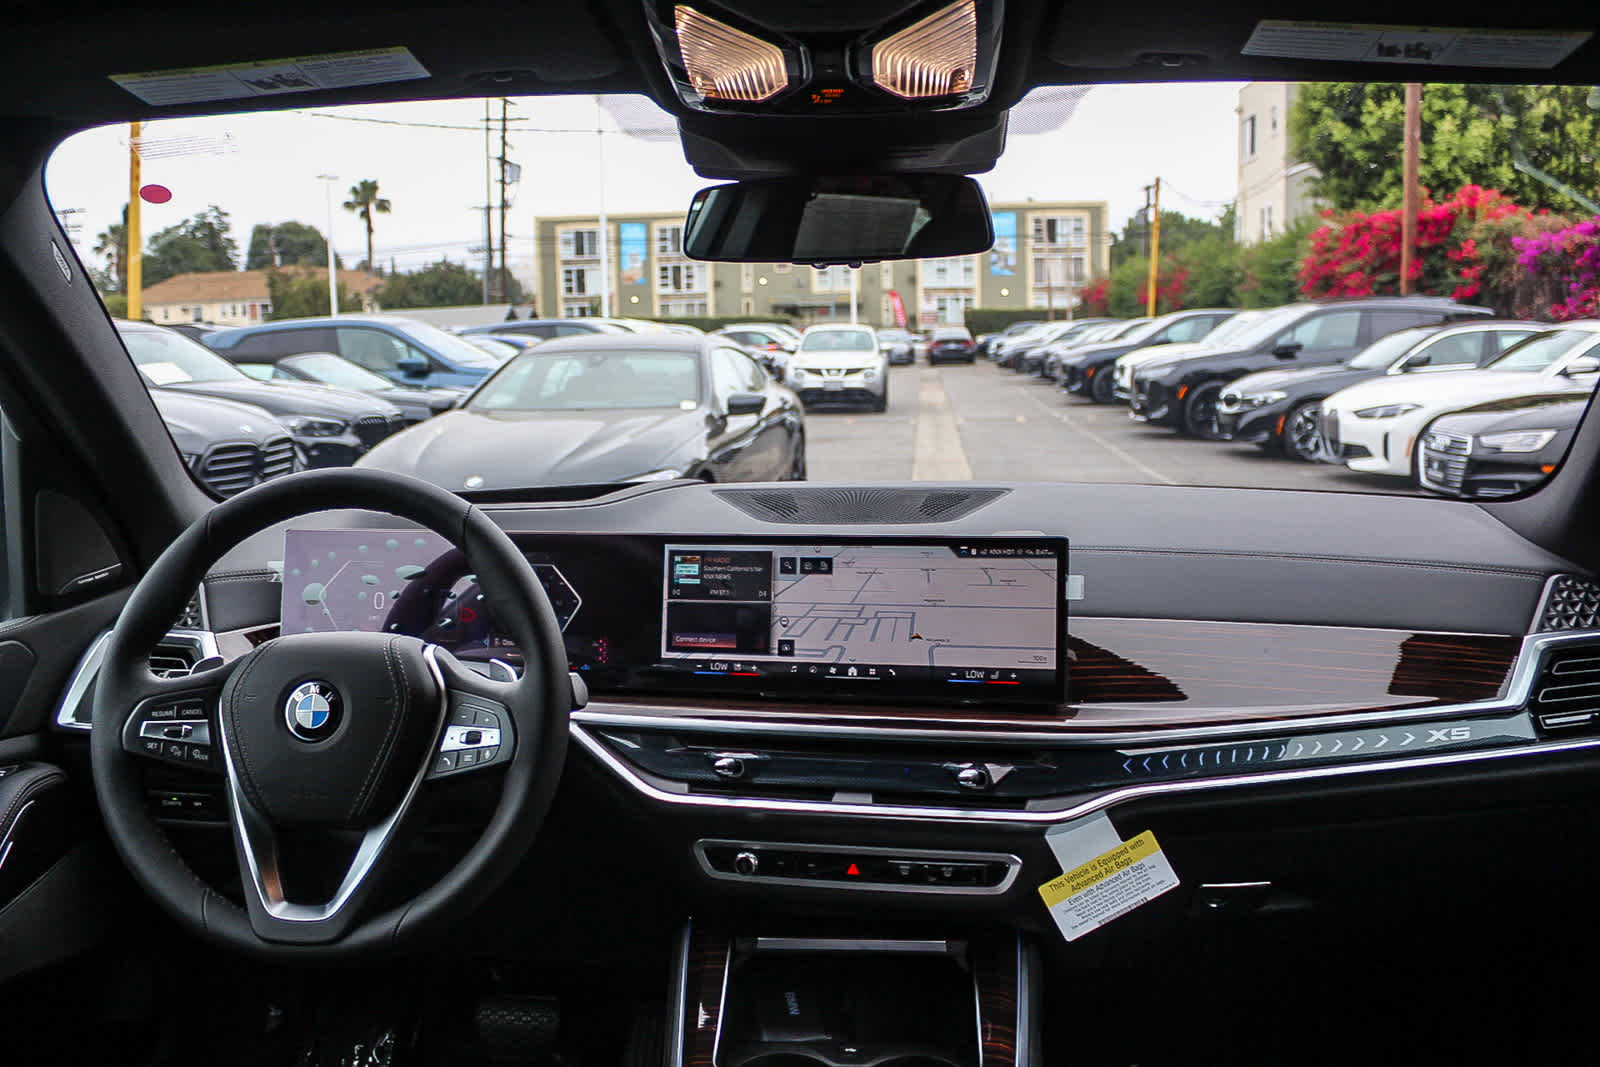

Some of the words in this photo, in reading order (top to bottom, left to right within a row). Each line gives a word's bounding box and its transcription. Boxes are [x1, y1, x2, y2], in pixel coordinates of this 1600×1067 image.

[375, 592, 384, 609] 0
[710, 662, 728, 671] LOW
[965, 670, 985, 679] LOW
[1425, 727, 1471, 743] X5
[1049, 880, 1065, 893] This
[1064, 867, 1090, 883] Vehicle
[1090, 863, 1098, 872] is
[1097, 846, 1129, 868] Equipped
[1129, 838, 1145, 849] with
[1071, 872, 1103, 892] Advanced
[1103, 864, 1115, 875] Air
[1114, 856, 1133, 870] Bags
[1067, 894, 1083, 905] Even
[1083, 886, 1097, 898] with
[1095, 873, 1122, 891] Advanced
[1122, 868, 1131, 877] Air
[1131, 862, 1146, 873] Bags
